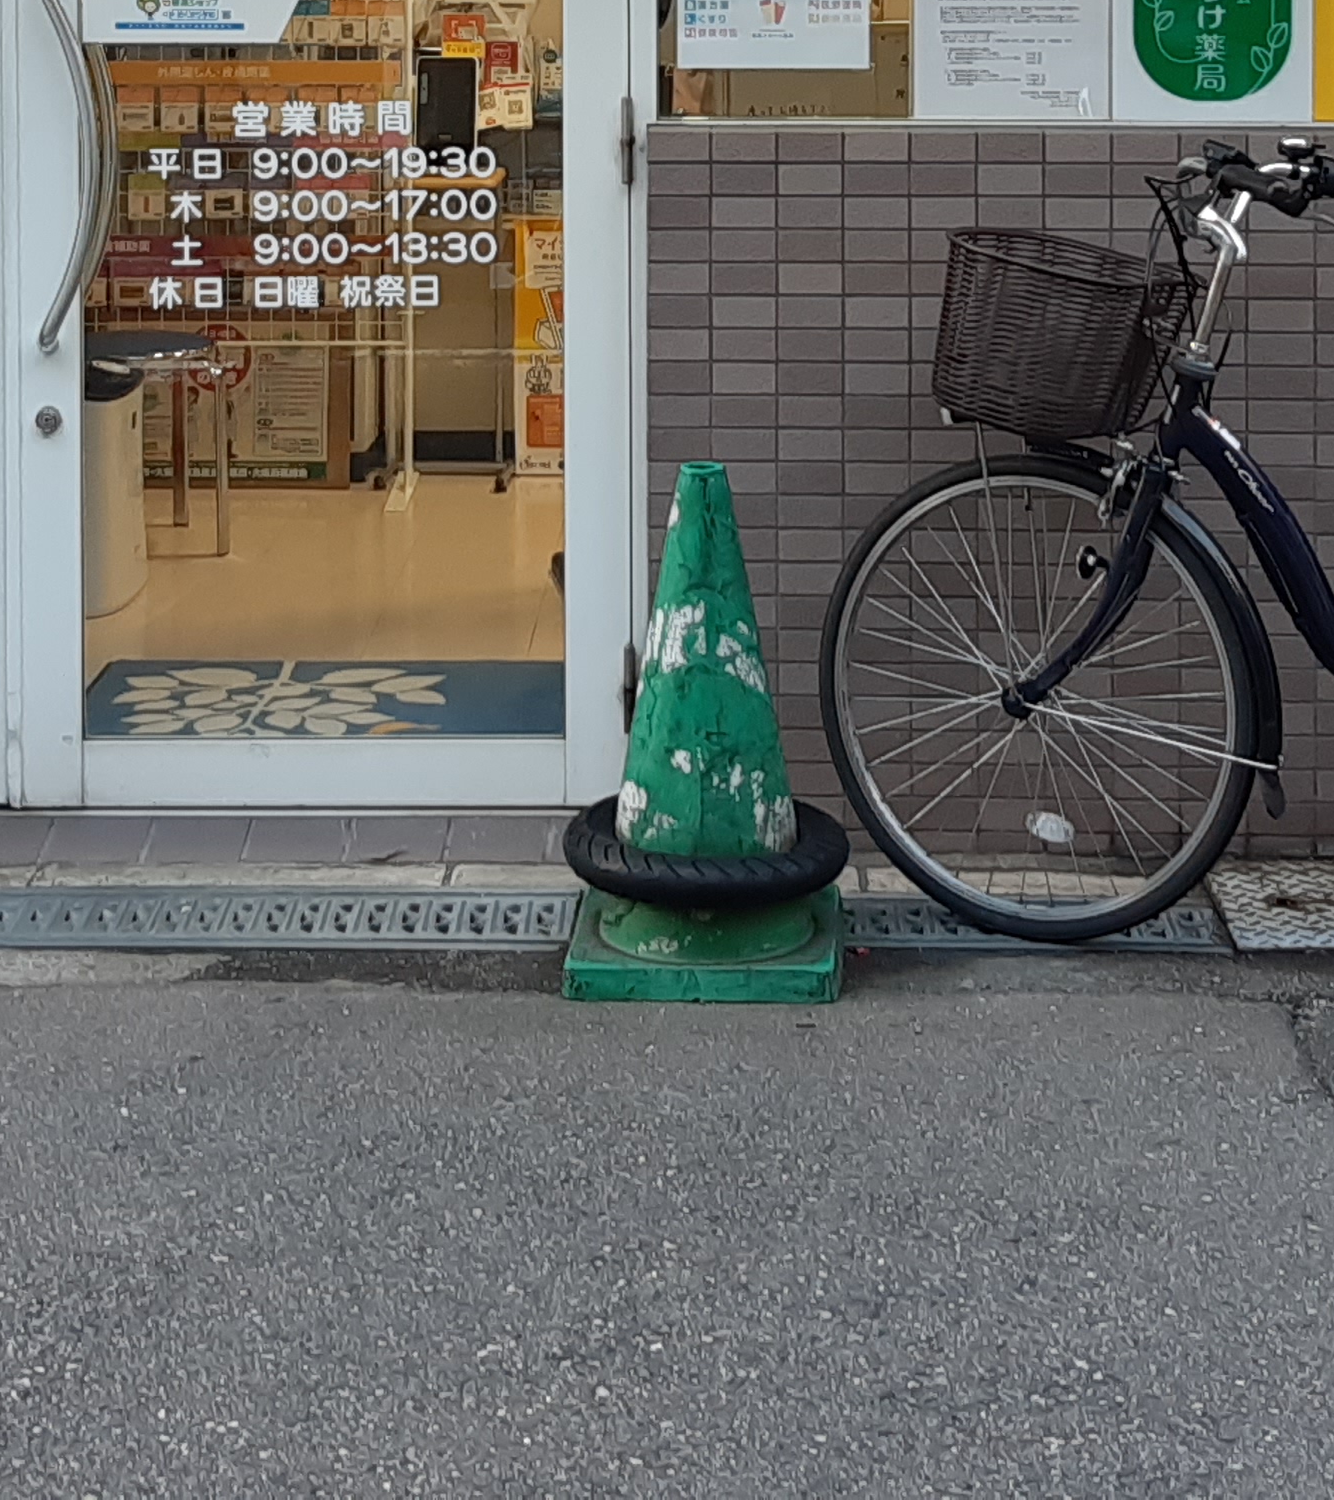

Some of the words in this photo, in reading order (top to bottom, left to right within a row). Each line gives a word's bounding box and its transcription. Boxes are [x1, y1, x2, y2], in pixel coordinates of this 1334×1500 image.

[232, 101, 413, 137] 営業時間
[147, 148, 223, 180] 平日
[169, 191, 204, 223] 木
[170, 234, 204, 266] 土
[149, 276, 224, 310] 休日
[254, 276, 320, 309] 日曜
[339, 275, 440, 308] 祝祭日
